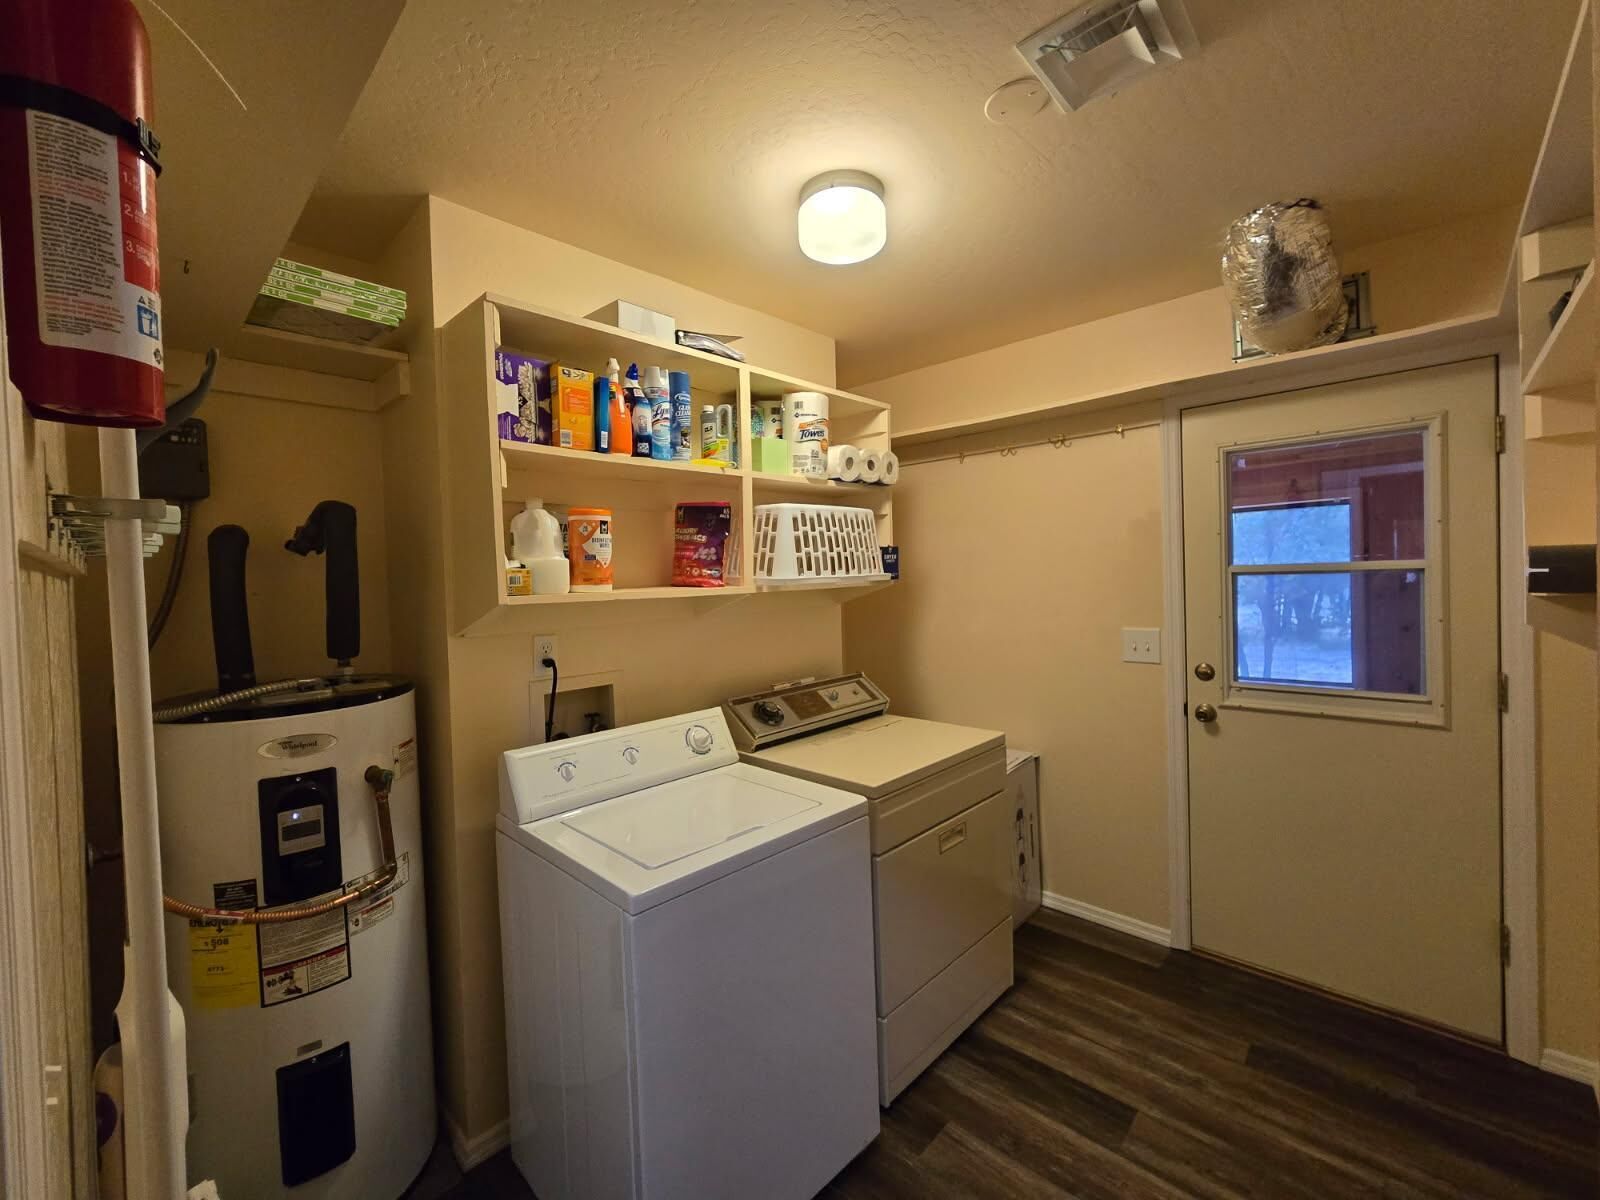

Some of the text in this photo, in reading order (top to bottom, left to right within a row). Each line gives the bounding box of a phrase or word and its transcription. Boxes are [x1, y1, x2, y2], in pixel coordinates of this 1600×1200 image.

[124, 203, 134, 218] 2.
[126, 239, 136, 254] 3.
[280, 740, 318, 751] Whirlpool
